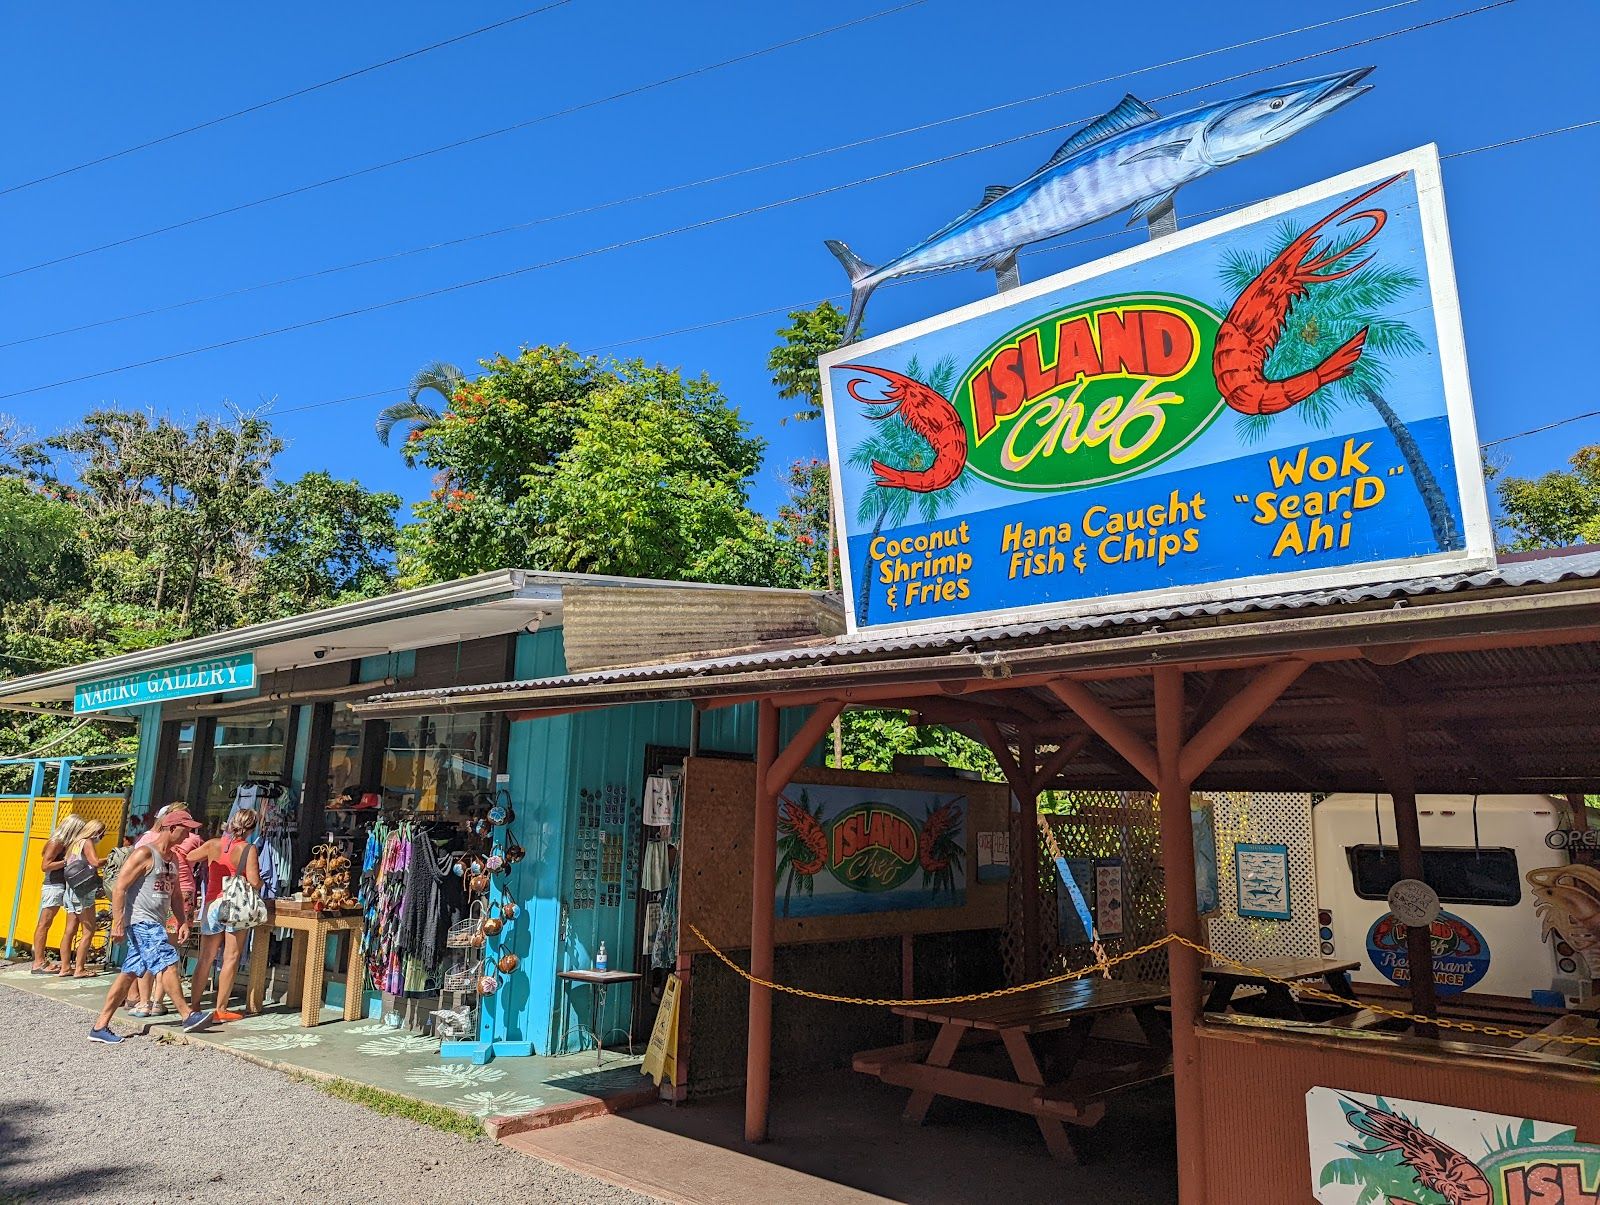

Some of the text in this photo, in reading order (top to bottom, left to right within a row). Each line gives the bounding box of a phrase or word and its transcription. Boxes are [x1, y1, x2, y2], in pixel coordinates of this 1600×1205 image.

[970, 307, 1198, 445] ISLAND
[1001, 378, 1184, 472] Chef
[869, 520, 970, 561] Coconut
[1001, 521, 1072, 554] Hana
[1008, 527, 1200, 580] Fish & Chips
[1270, 511, 1353, 558] Ahi
[879, 550, 973, 585] Shrimp
[886, 577, 971, 612] & Fries
[80, 658, 241, 709] NAHIKU GALLERY
[833, 811, 917, 868] ISLAND
[1545, 830, 1600, 849] OPE
[847, 850, 903, 885] Chef
